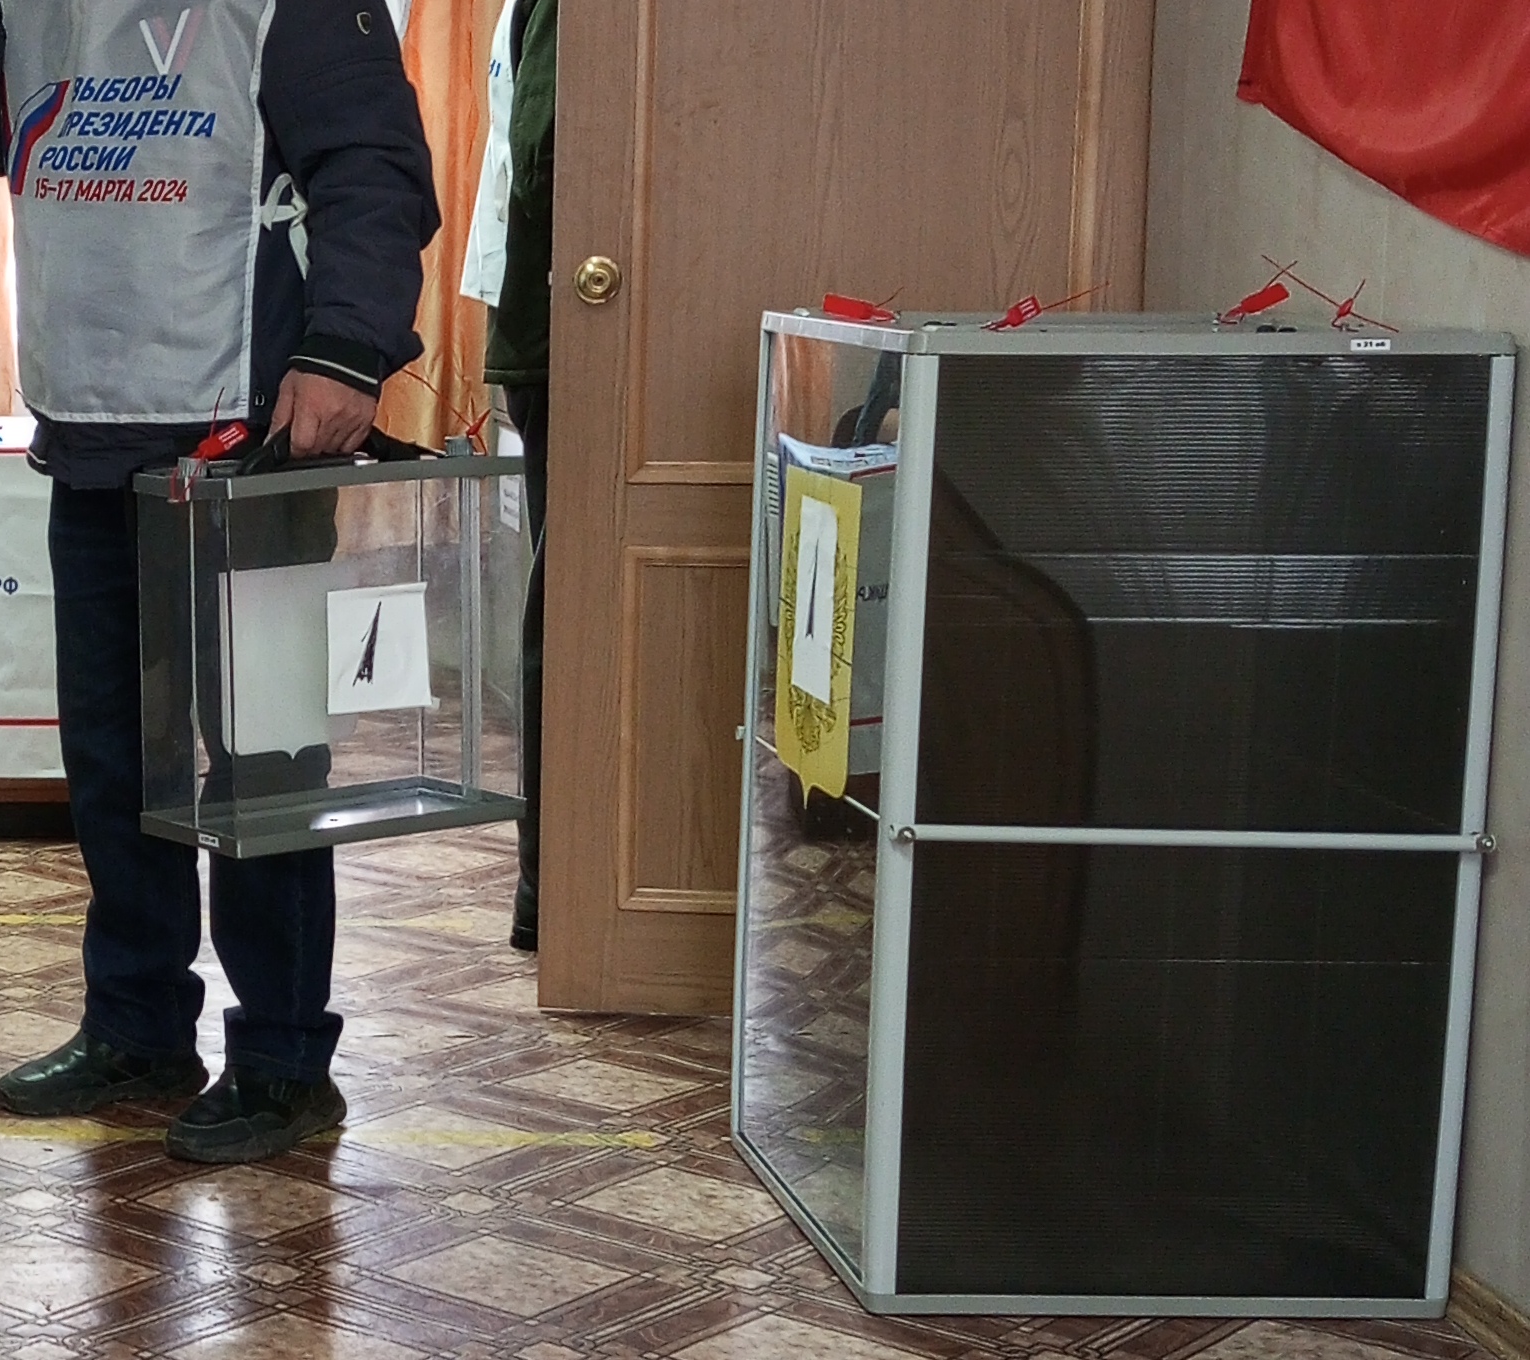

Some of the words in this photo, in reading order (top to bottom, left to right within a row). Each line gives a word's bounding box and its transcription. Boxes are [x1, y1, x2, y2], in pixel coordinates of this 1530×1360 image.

[38, 145, 137, 171] РОССИИ
[74, 179, 135, 202] МАРТА
[137, 179, 188, 203] 2024
